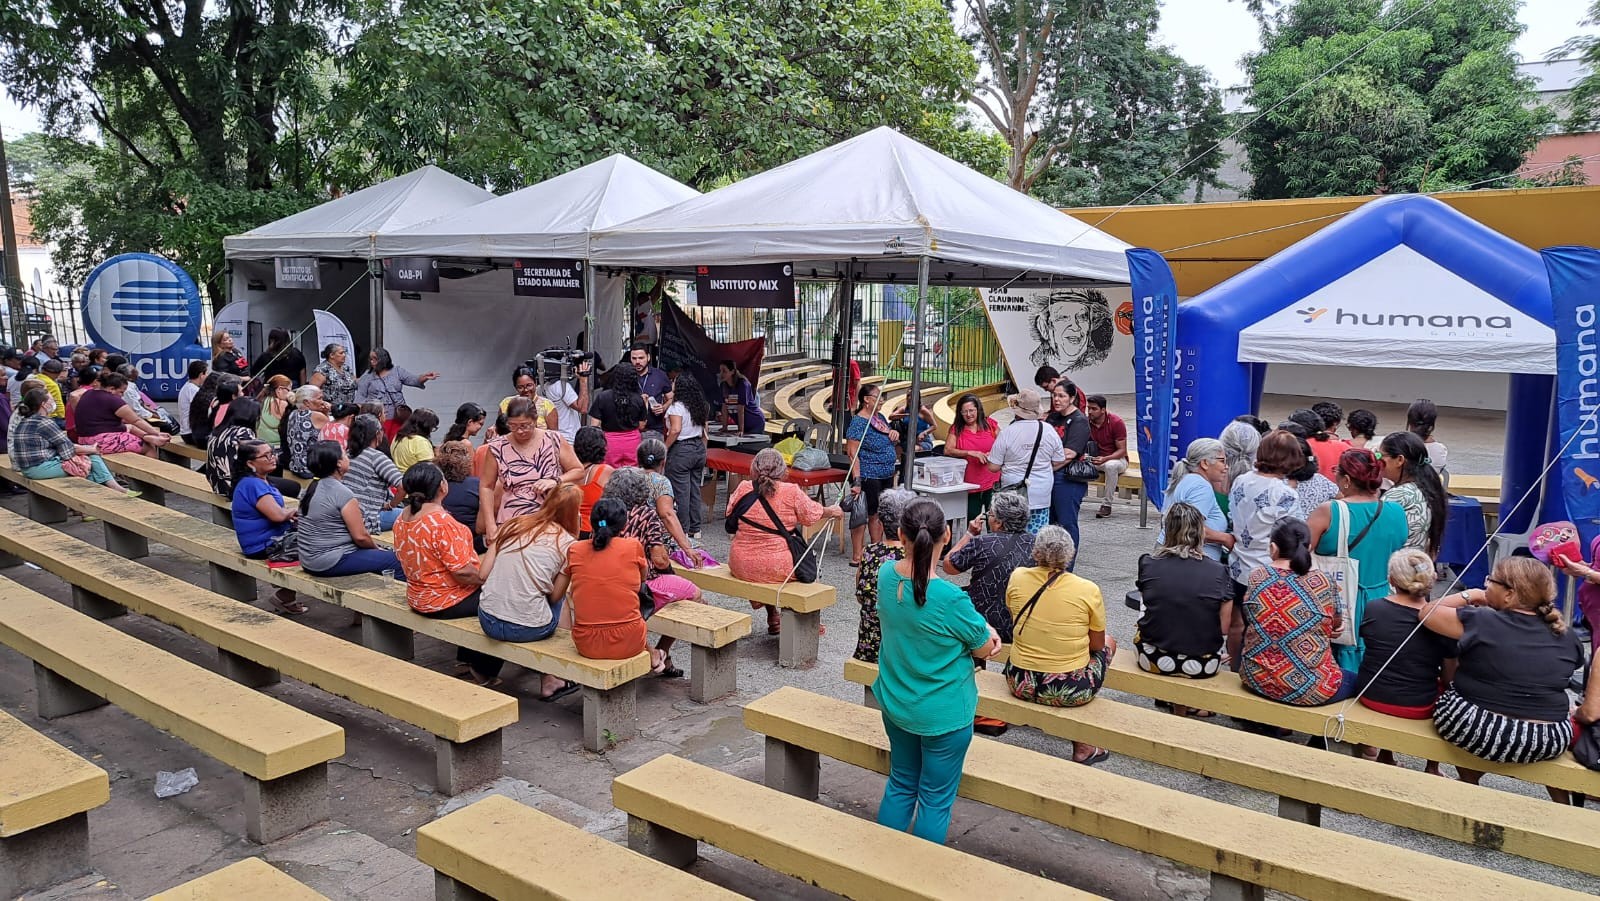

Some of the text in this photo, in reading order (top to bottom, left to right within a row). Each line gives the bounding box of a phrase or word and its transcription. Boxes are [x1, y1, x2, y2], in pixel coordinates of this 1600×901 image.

[282, 266, 312, 274] INSTITUTO DE
[398, 269, 422, 280] OAB-PI
[524, 268, 572, 278] SECRETARIA DE
[281, 273, 314, 282] IDENTIFICAÇÃO
[518, 278, 580, 288] ESTADO DA MULHER
[710, 279, 779, 291] INSTITUTO MIX
[1335, 308, 1512, 329] humana
[1161, 303, 1169, 377] NORDESTE
[1142, 296, 1153, 420] humana
[1184, 348, 1196, 418] SAÚDE
[1573, 304, 1600, 460] humana
